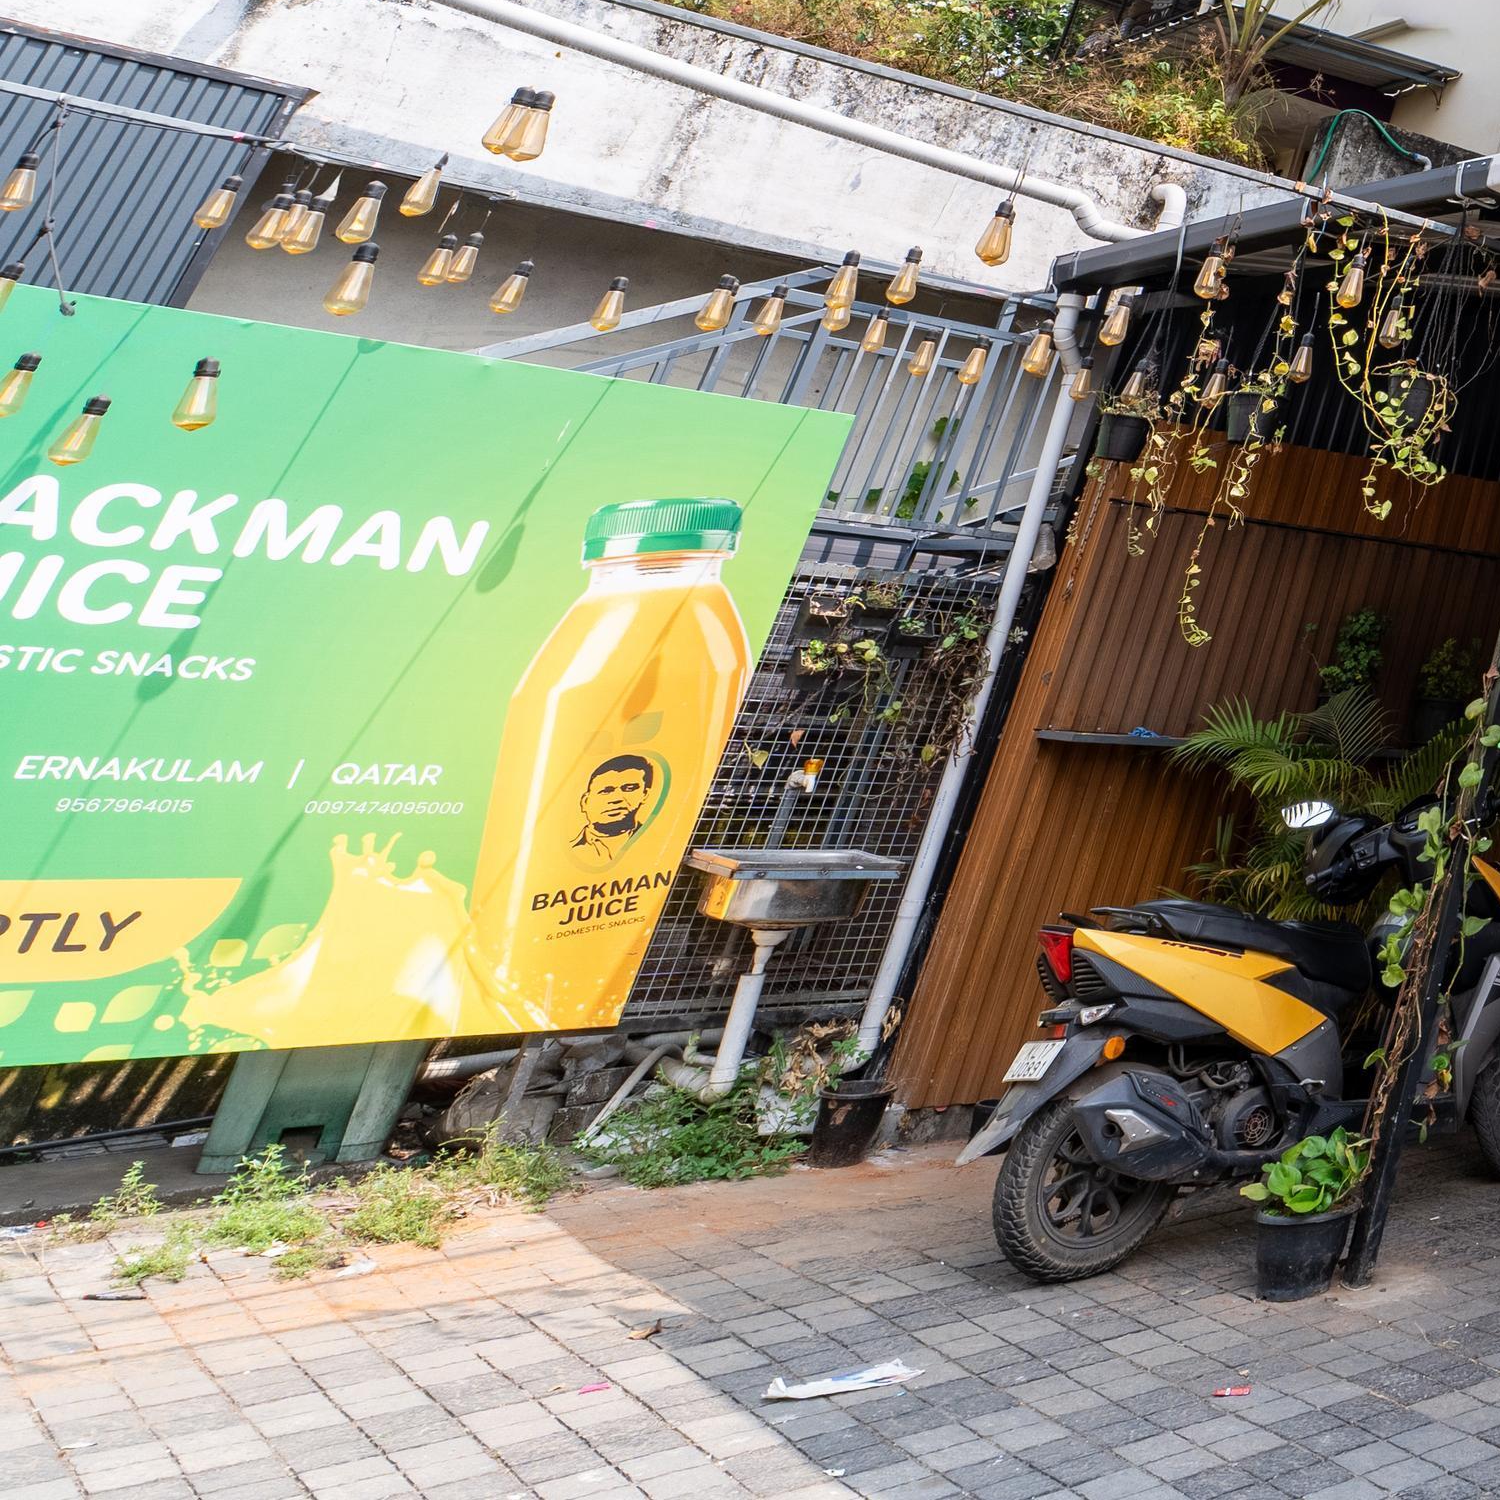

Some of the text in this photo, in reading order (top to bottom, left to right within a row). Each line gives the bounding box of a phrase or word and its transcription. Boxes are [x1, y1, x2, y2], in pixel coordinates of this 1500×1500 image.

[90, 649, 257, 682] SNACKS
[13, 755, 444, 787] ERNAKULAM QATAR
[55, 797, 464, 815] 9567964015 0097474095000
[531, 870, 672, 911] BACKMAN
[559, 895, 639, 925] JUICE
[556, 923, 606, 939] DOMESTIC
[608, 915, 646, 929] SNACKS
